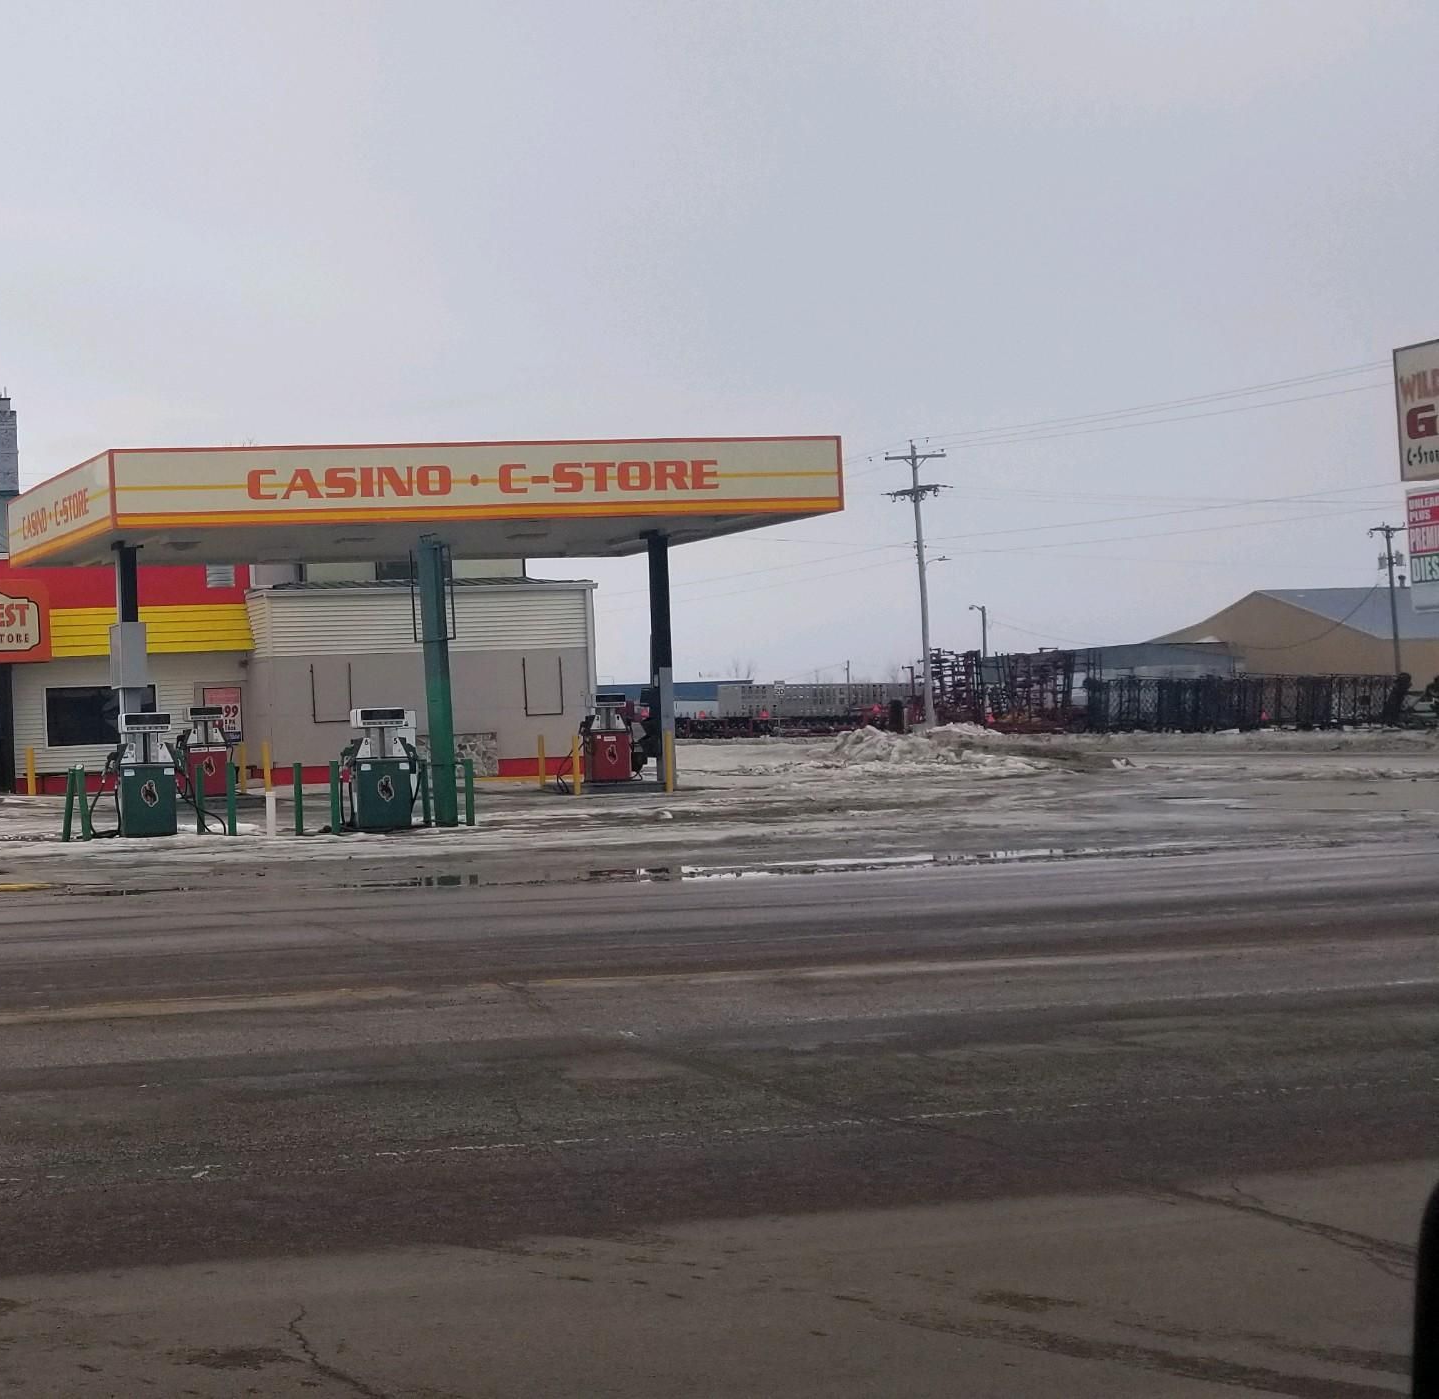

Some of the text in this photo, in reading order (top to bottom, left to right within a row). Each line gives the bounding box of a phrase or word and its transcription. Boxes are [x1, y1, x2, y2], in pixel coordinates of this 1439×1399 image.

[247, 460, 720, 500] CASINO C-STORE
[22, 488, 89, 540] CASINO C-STORE
[1409, 510, 1431, 522] PLUS
[224, 704, 239, 718] 99
